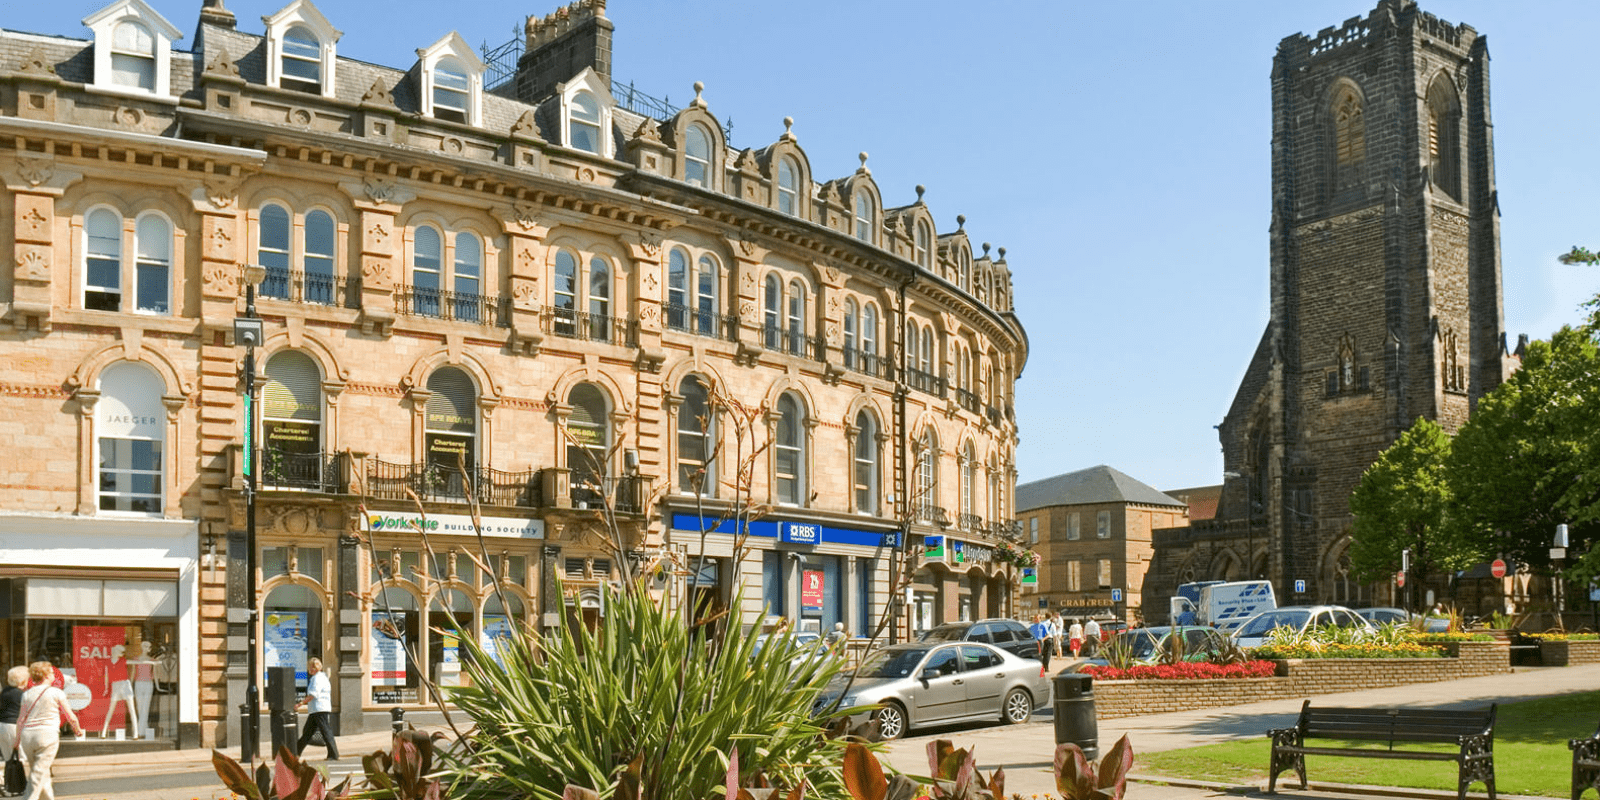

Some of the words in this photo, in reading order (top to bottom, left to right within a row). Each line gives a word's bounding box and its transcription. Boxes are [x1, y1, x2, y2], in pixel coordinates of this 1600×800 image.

[107, 415, 157, 425] JAEGER
[444, 524, 492, 533] BUILDNG
[496, 526, 538, 535] SOCIETY
[799, 525, 815, 538] RBS
